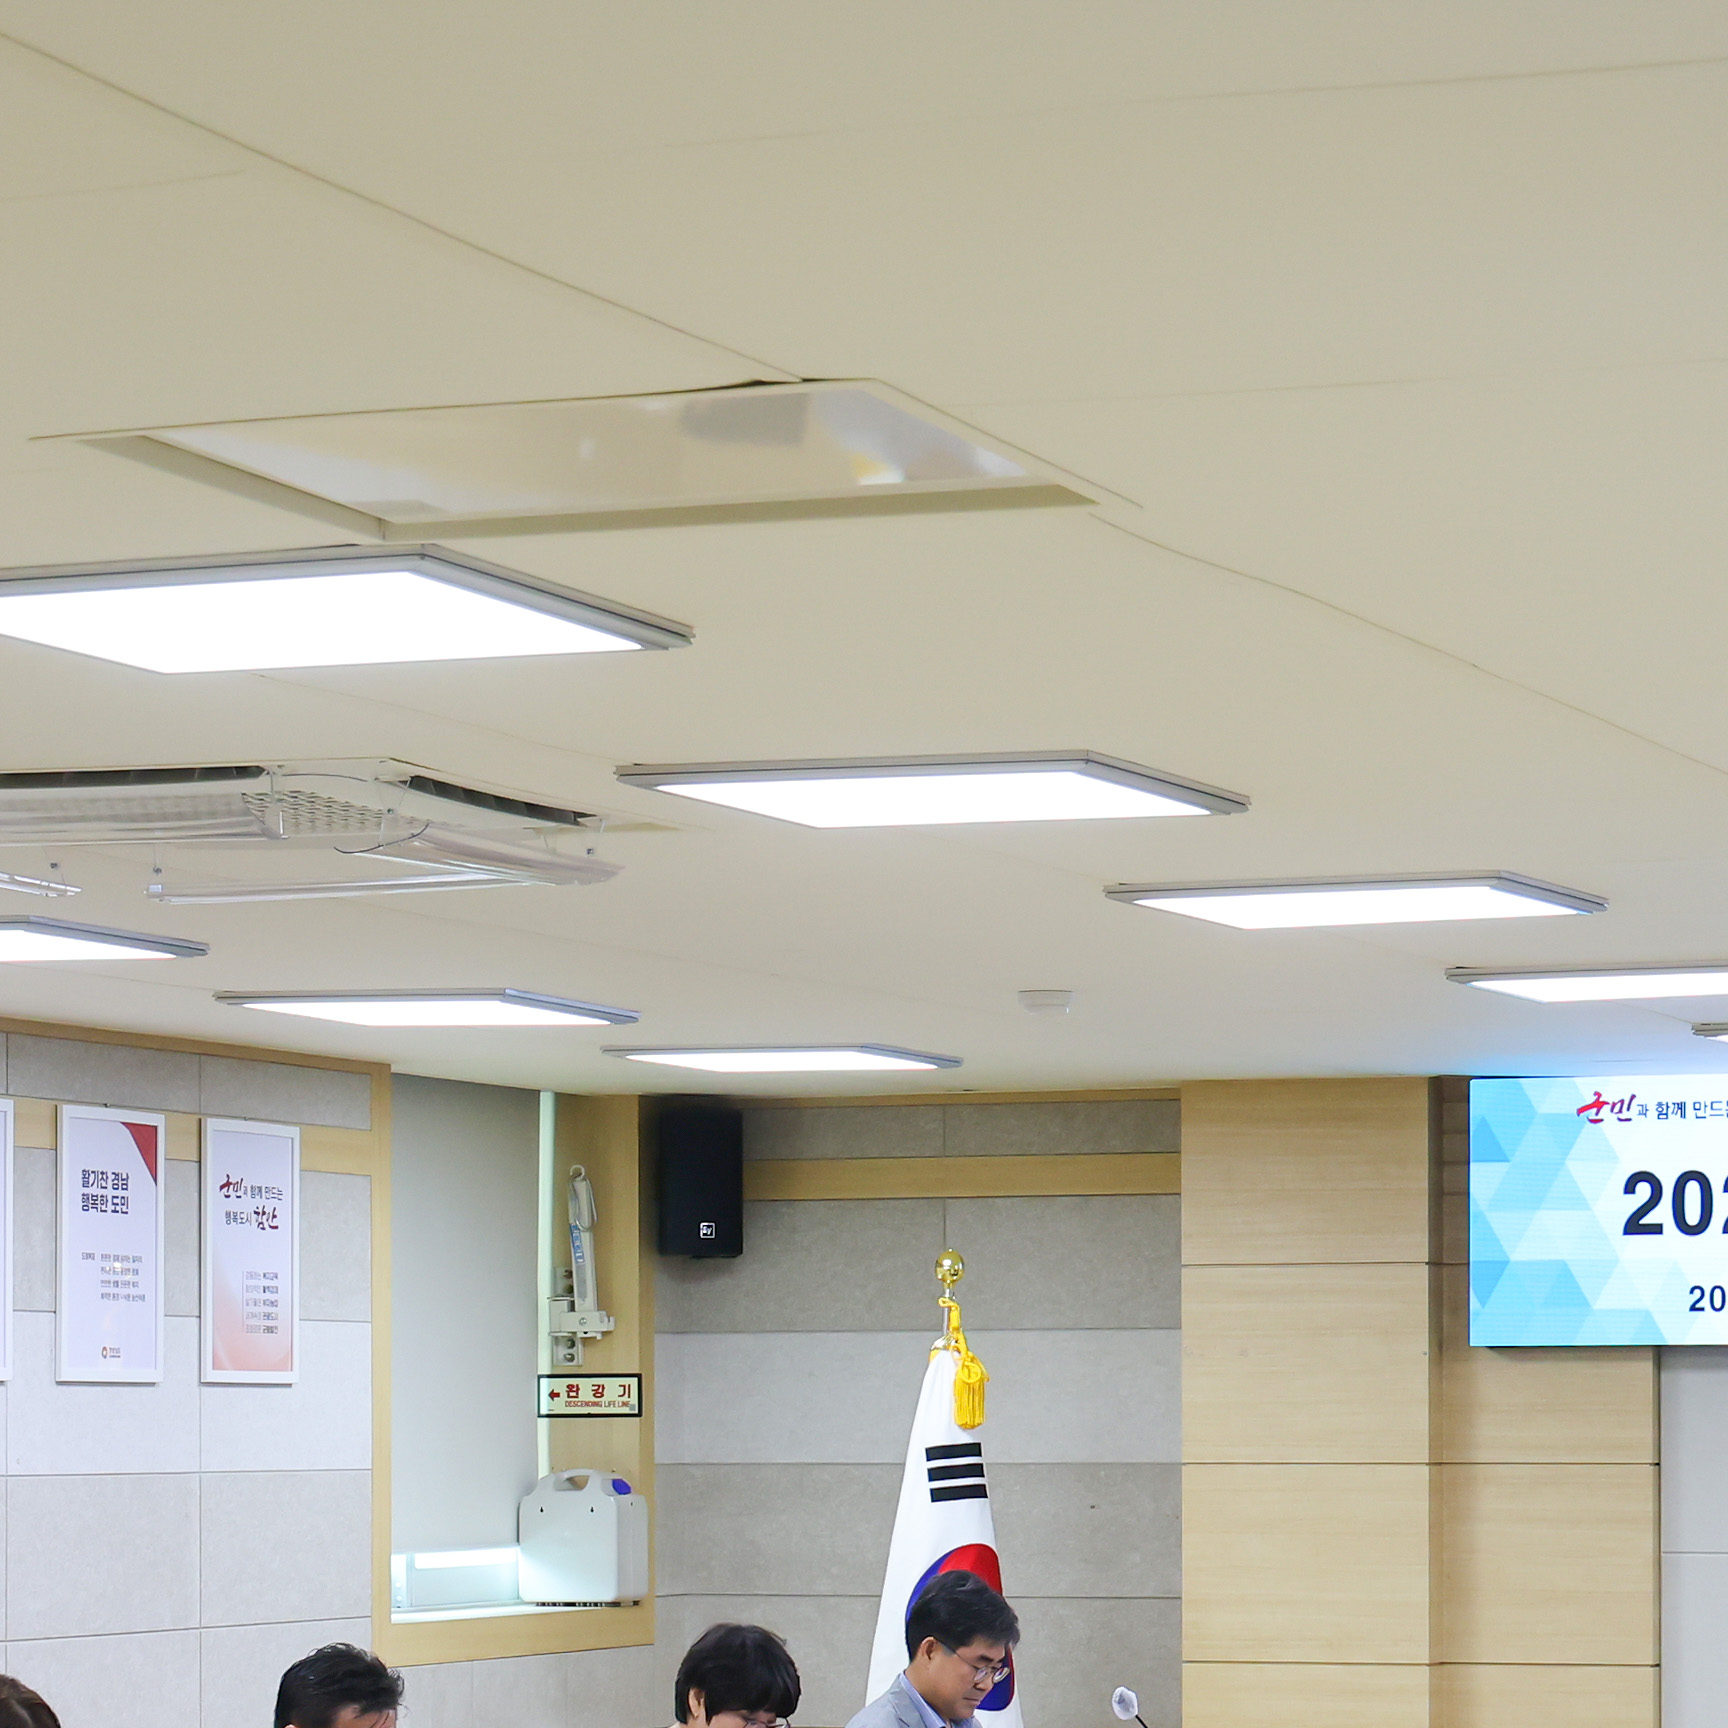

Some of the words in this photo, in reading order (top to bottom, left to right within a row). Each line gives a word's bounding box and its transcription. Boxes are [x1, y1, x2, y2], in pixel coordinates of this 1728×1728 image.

[1576, 1090, 1649, 1124] 군민과
[1655, 1101, 1687, 1120] 함께
[81, 1168, 109, 1189] 활기찬
[111, 1171, 129, 1191] 경남
[81, 1192, 109, 1213] 행복한
[111, 1195, 129, 1214] 도민
[225, 1210, 252, 1227] 행복도시
[564, 1400, 603, 1408] DESCENDING
[603, 1400, 617, 1408] LIFE
[617, 1400, 631, 1408] LINE
